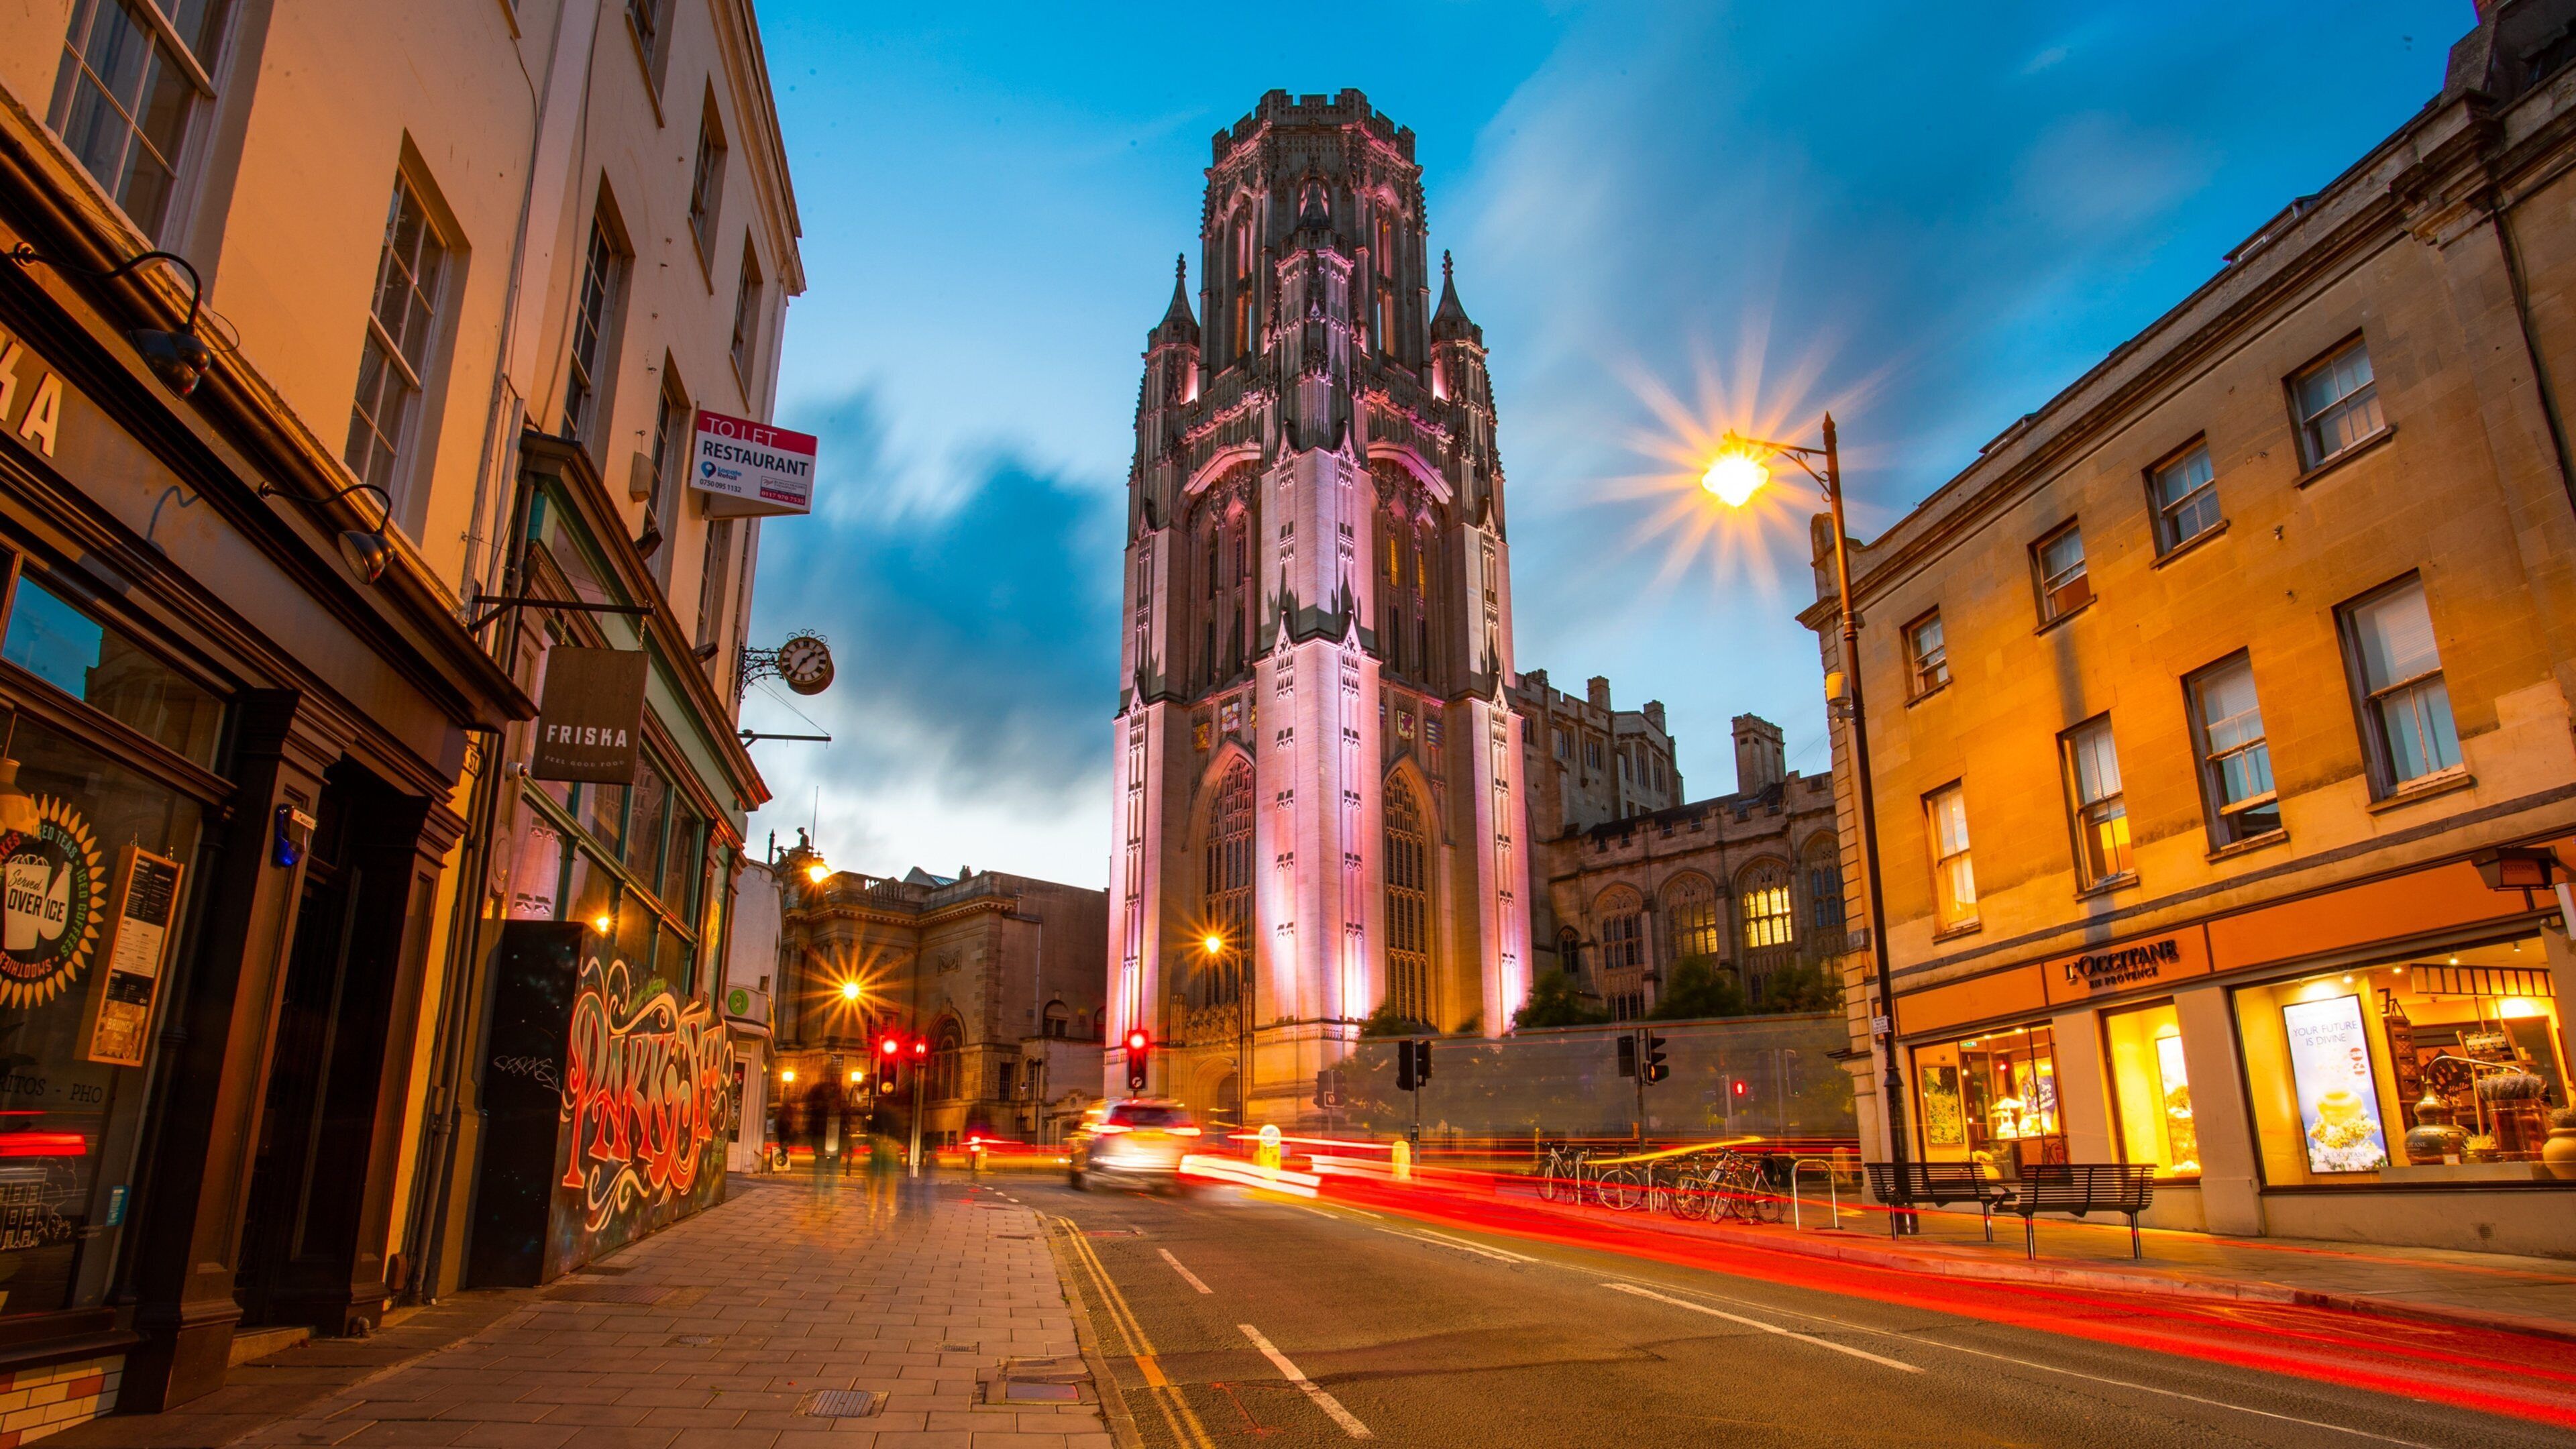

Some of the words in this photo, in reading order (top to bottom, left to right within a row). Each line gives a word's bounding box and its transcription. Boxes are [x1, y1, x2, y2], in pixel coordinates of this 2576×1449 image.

[706, 417, 735, 437] TO
[741, 425, 777, 447] LET
[703, 440, 808, 476] RESTAURANT
[718, 467, 742, 476] Locate
[718, 472, 737, 480] Retail
[700, 478, 714, 487] 0750
[715, 482, 726, 490] 095
[727, 484, 741, 492] 1132
[547, 724, 627, 747] FRISKA
[544, 755, 565, 765] FEEL
[56, 830, 78, 859] TEAS
[8, 869, 43, 891] Served
[76, 868, 88, 899] ICED
[7, 888, 43, 917] OVER
[44, 898, 66, 923] ICE
[60, 903, 87, 957] COFFEES
[0, 951, 52, 978] SMOOTHIES
[2089, 979, 2102, 989] EN
[2105, 967, 2159, 986] PROVENCE
[2293, 1026, 2318, 1036] YOUR
[2322, 1020, 2358, 1033] FUTURE
[2306, 1037, 2314, 1046] IS
[2316, 1033, 2347, 1045] DIVINE
[70, 1083, 103, 1104] PHO
